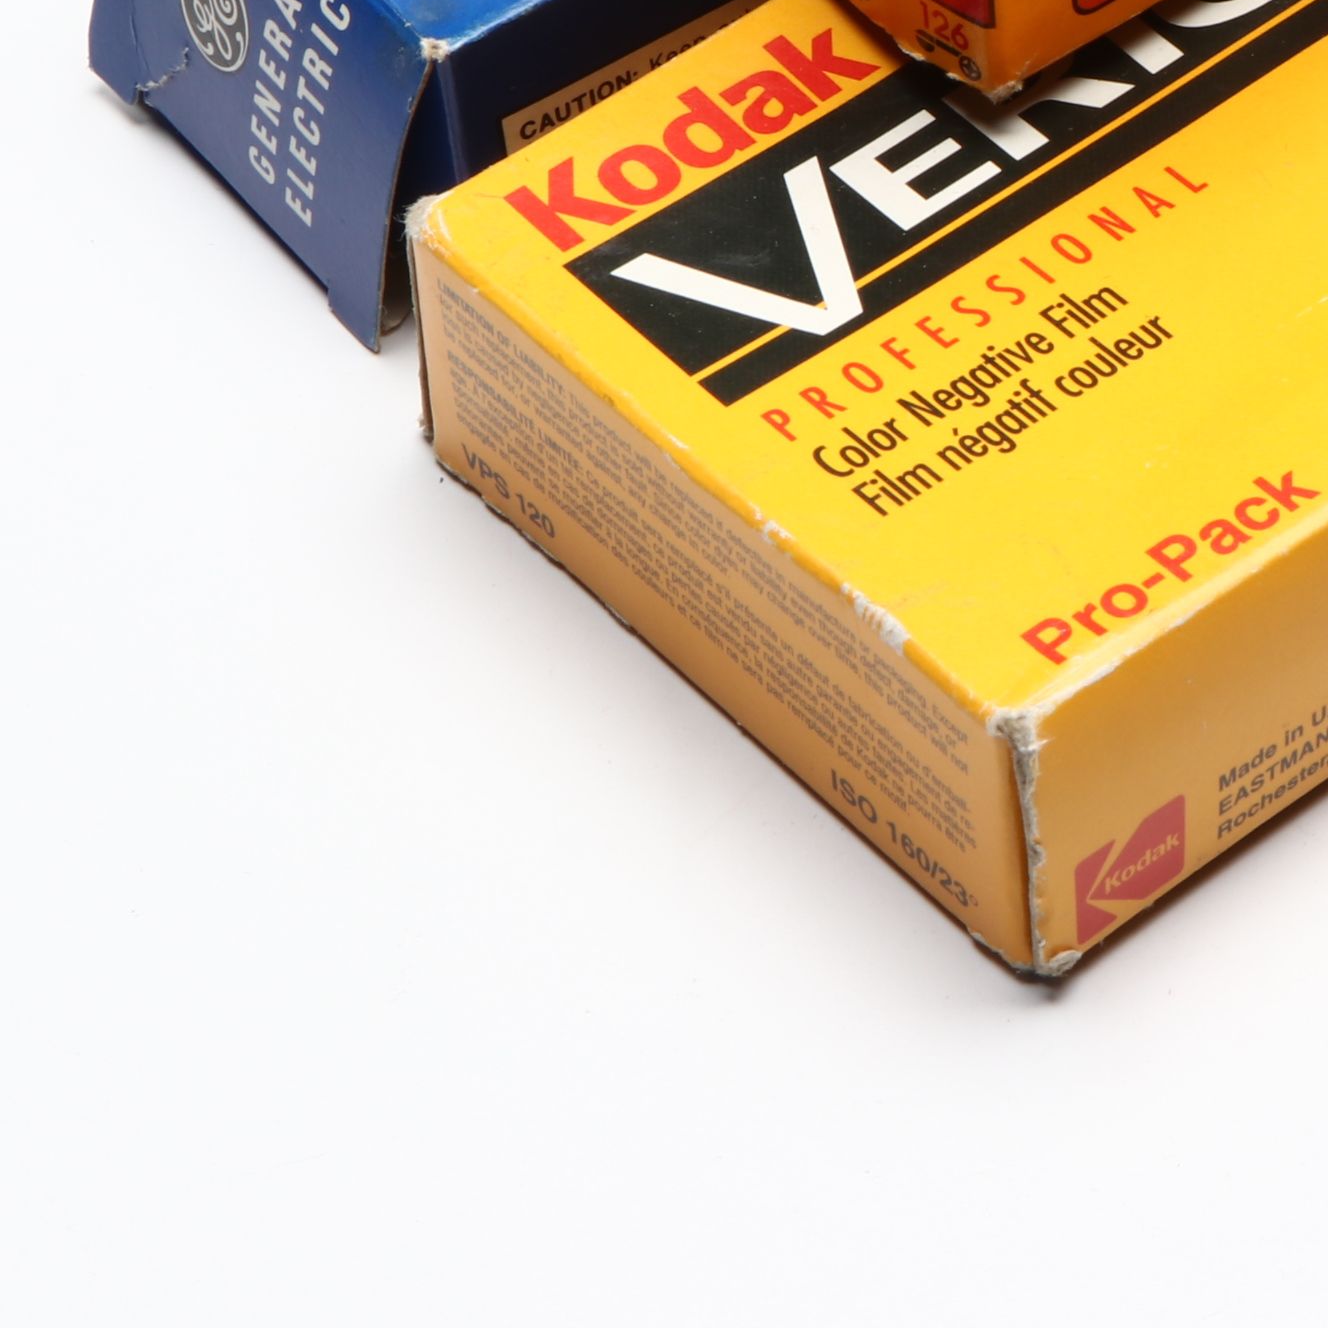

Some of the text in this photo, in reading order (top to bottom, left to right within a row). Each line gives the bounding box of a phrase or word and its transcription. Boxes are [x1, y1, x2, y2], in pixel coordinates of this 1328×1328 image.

[920, 0, 969, 51] 126
[504, 28, 881, 252] Kodak
[760, 166, 1208, 442] PROFESSIONAL
[812, 285, 1129, 478] Color Negative Film
[852, 315, 1174, 517] Film négatif couleur
[461, 442, 556, 539] VPS 120
[1020, 470, 1321, 665] Pro-Pack
[830, 769, 878, 825] ISO
[1218, 745, 1277, 792] Made
[1284, 725, 1304, 747] in
[1105, 833, 1181, 895] Kodak
